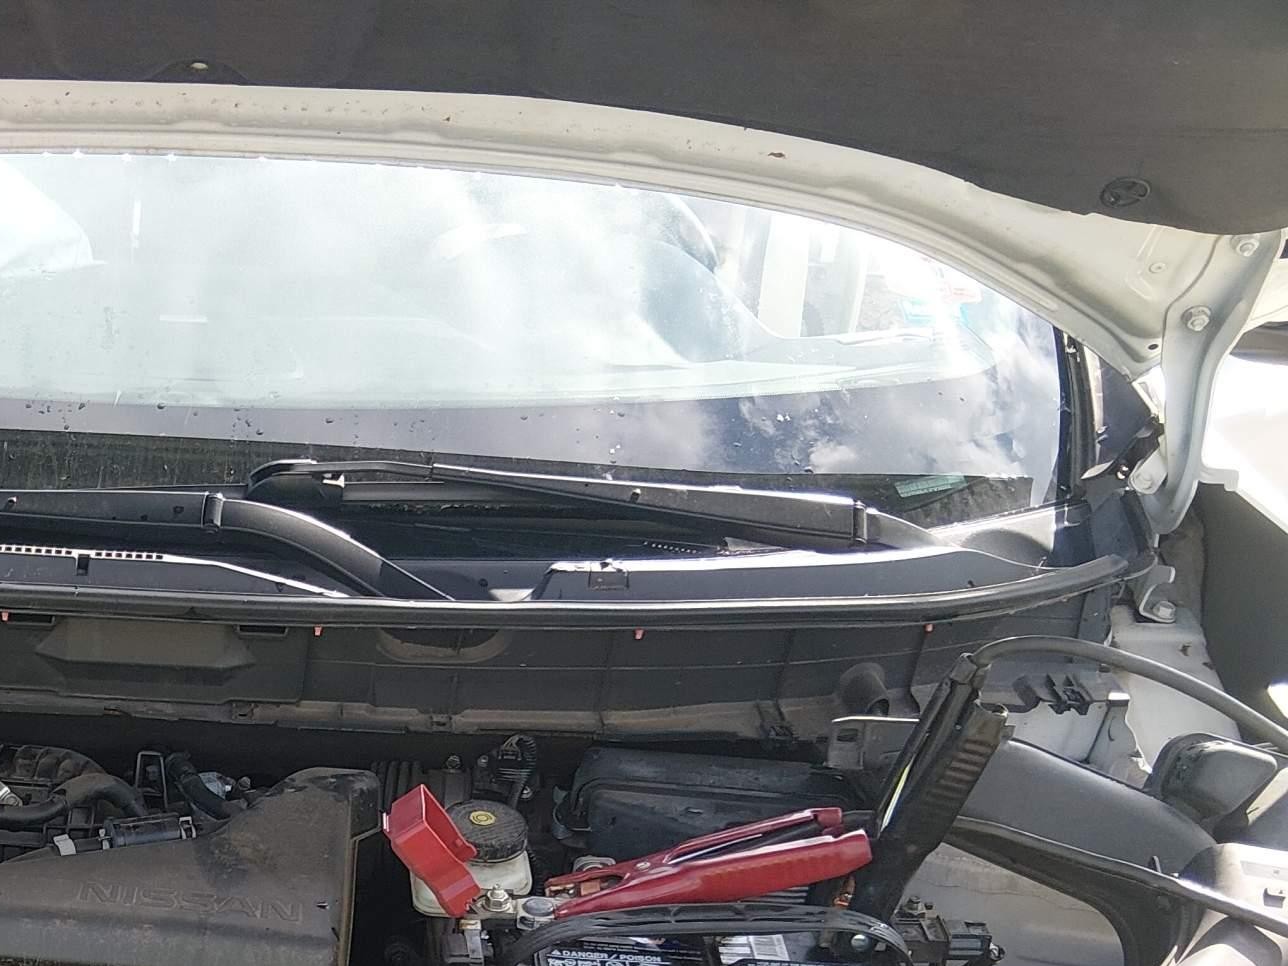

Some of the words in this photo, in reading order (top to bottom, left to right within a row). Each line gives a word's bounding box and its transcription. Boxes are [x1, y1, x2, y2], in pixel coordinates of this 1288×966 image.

[77, 880, 303, 924] NISSAN
[562, 950, 609, 959] DANGER
[619, 954, 662, 963] POISON
